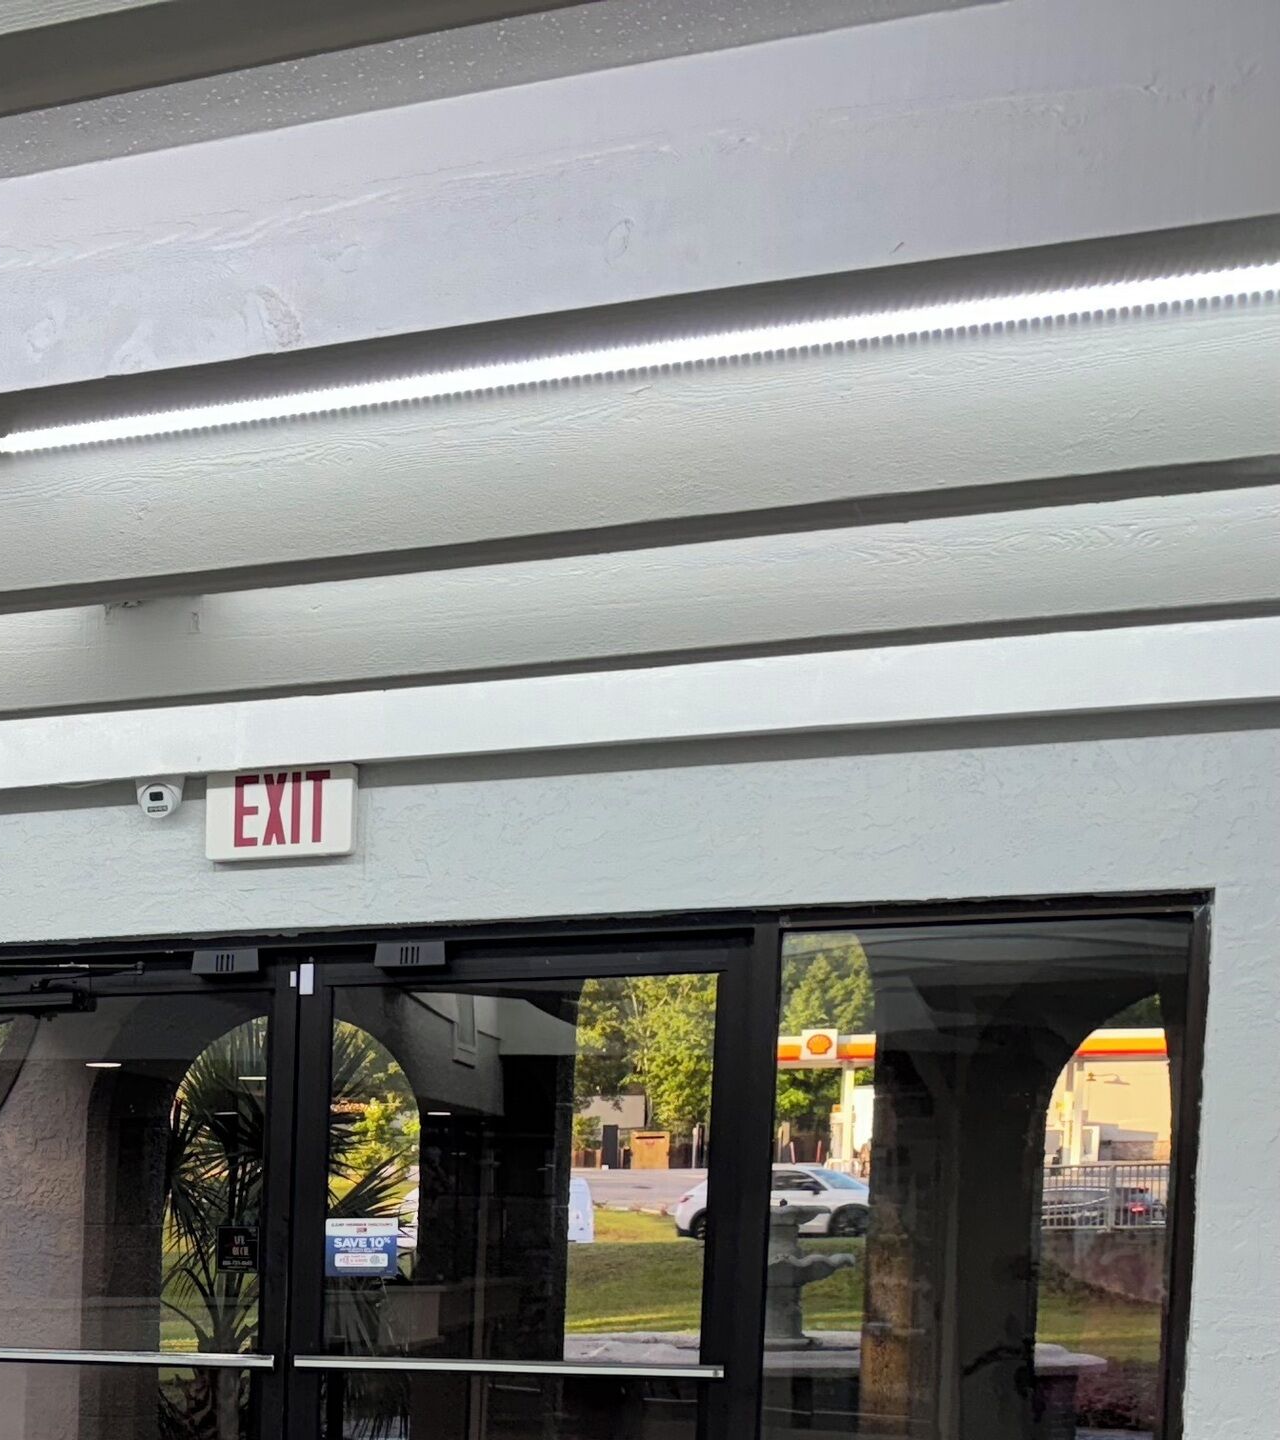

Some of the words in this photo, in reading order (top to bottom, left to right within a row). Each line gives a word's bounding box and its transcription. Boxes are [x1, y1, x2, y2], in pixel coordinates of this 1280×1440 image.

[234, 769, 331, 848] EXIT
[333, 1236, 368, 1249] SAVE
[369, 1236, 392, 1248] 10%
